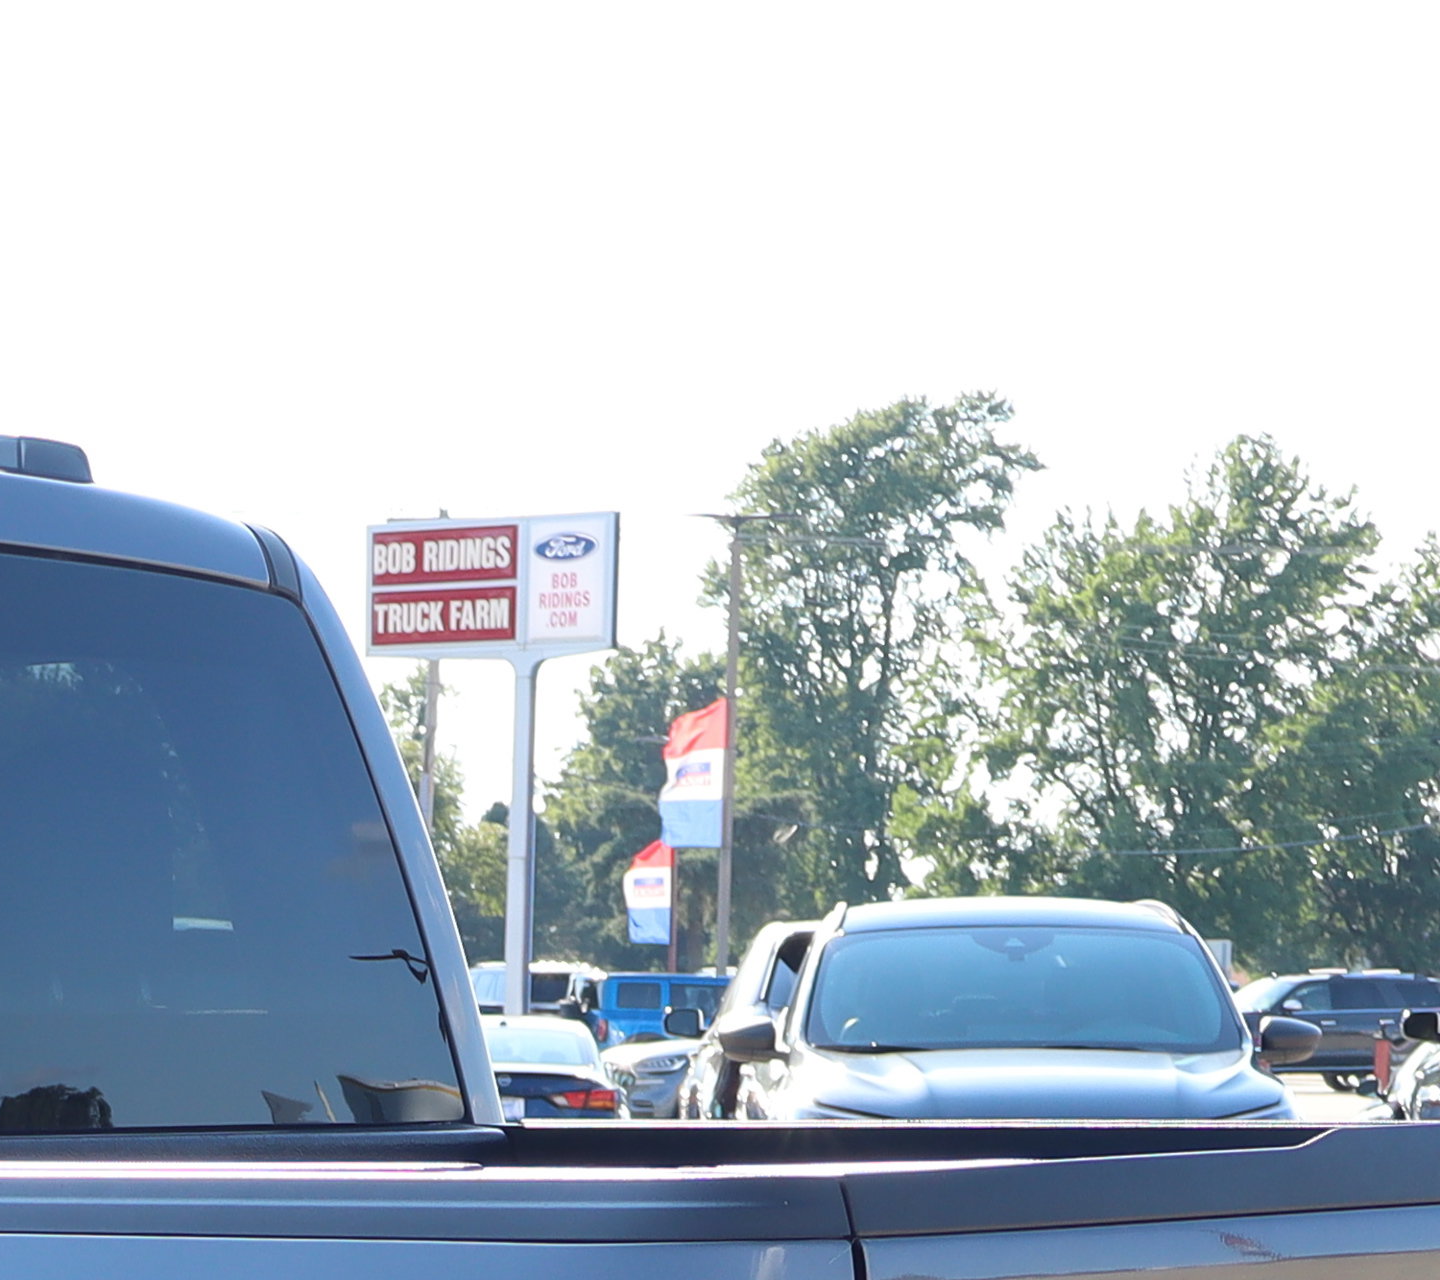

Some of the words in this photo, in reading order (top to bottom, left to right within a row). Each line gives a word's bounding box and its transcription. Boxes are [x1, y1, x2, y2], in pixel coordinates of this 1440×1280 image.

[374, 542, 416, 576] BOB
[422, 536, 512, 572] RIDINGS
[544, 535, 586, 559] Ford
[551, 573, 578, 590] BOB
[539, 591, 590, 608] RIDINGS
[374, 602, 444, 634] TRUCK
[449, 598, 509, 631] FARM
[546, 611, 578, 628] .COM
